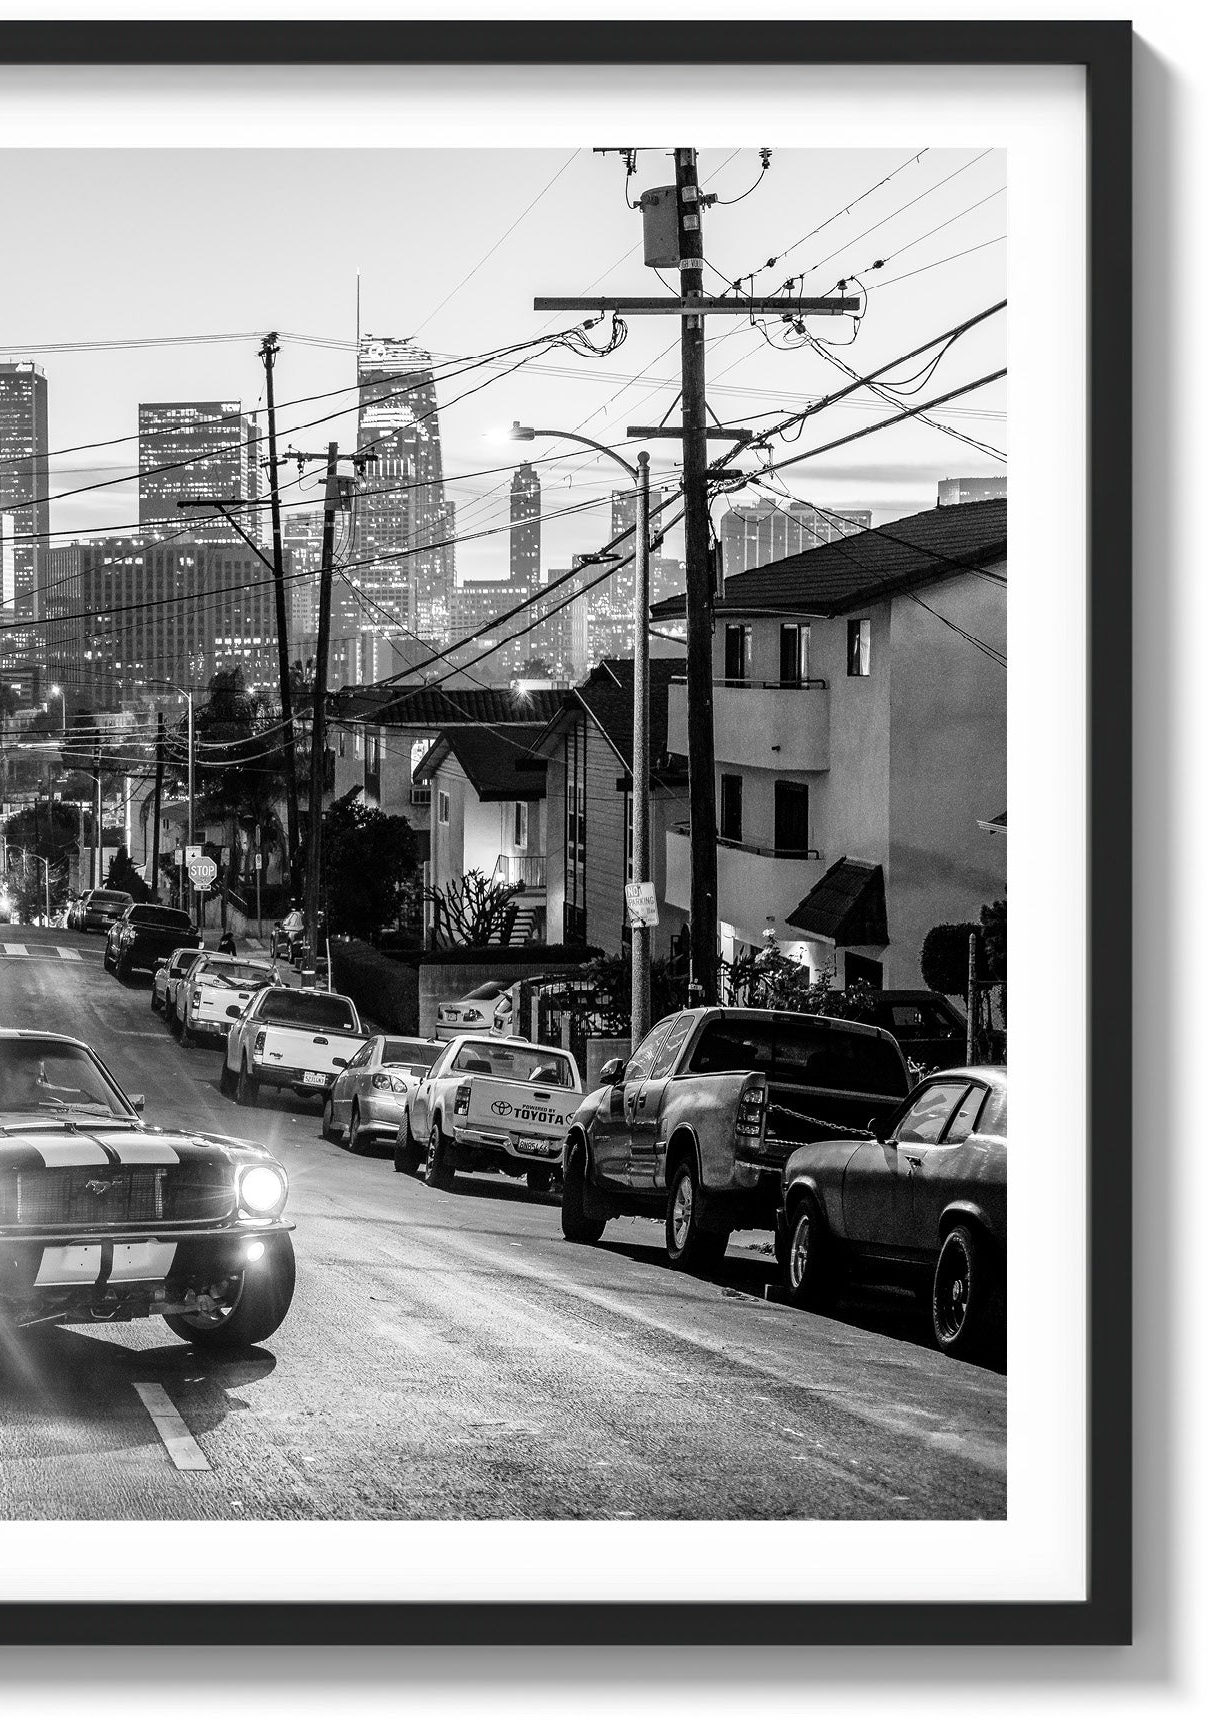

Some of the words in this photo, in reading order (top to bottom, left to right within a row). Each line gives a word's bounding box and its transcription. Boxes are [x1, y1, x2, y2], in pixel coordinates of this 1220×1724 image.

[221, 404, 240, 412] TCW
[190, 865, 215, 876] STOP
[627, 886, 640, 897] NO
[628, 896, 655, 907] PARKING
[522, 1104, 548, 1113] POWERED
[514, 1108, 564, 1125] TOYOTA
